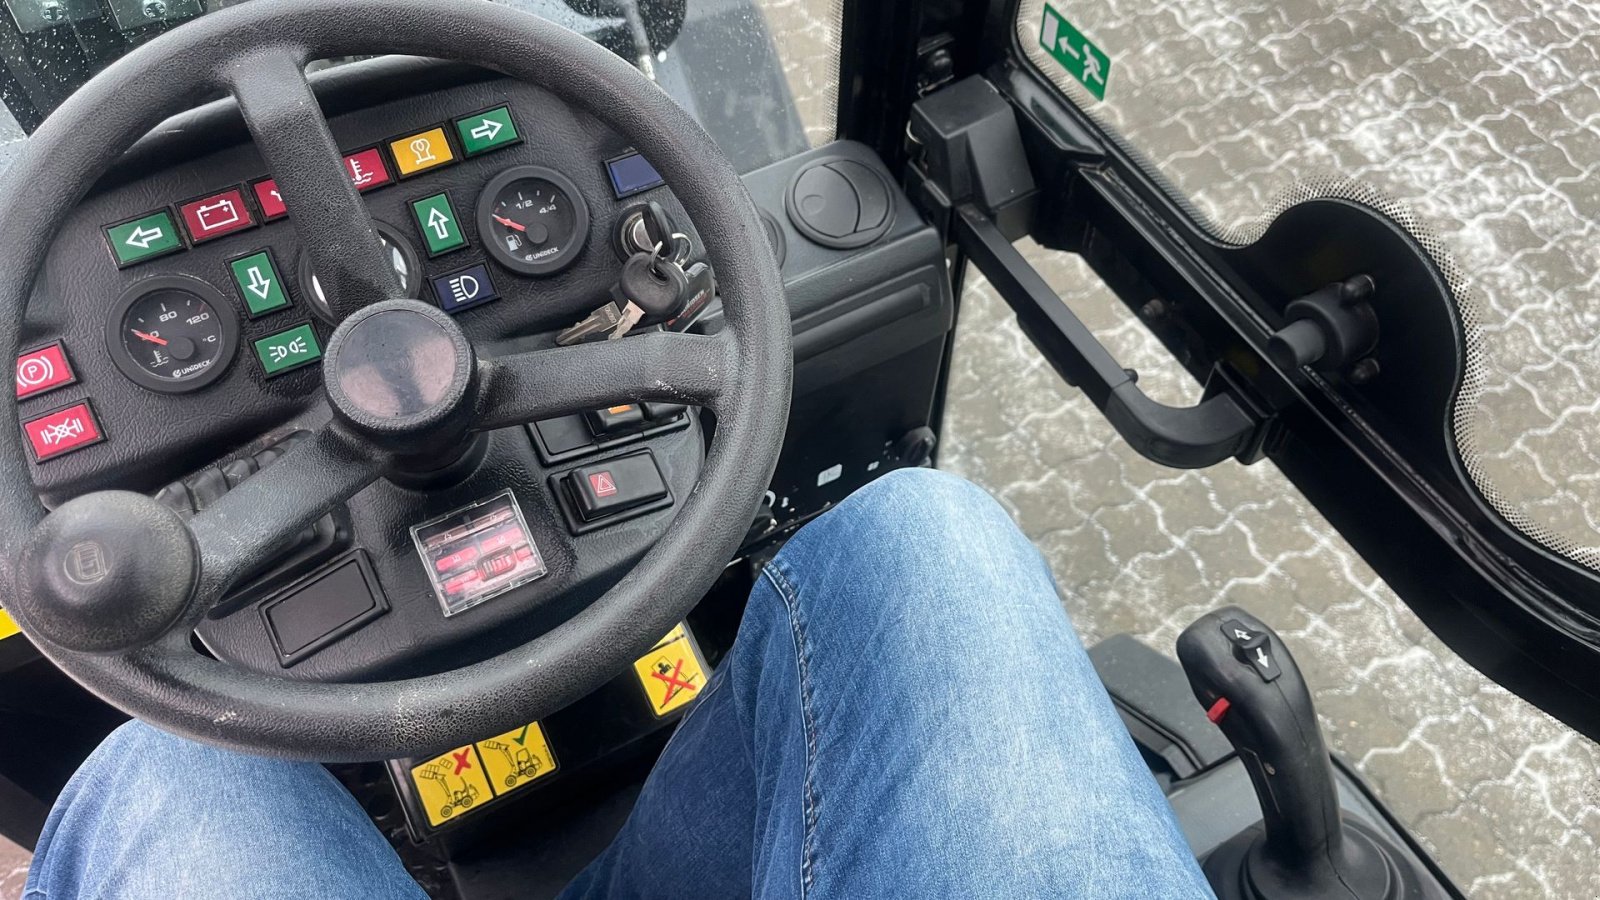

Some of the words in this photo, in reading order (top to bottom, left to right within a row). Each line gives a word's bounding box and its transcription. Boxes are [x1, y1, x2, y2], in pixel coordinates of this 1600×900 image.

[516, 200, 534, 210] 1/2
[539, 204, 556, 214] 4/4
[159, 311, 177, 322] 80
[186, 312, 209, 325] 120
